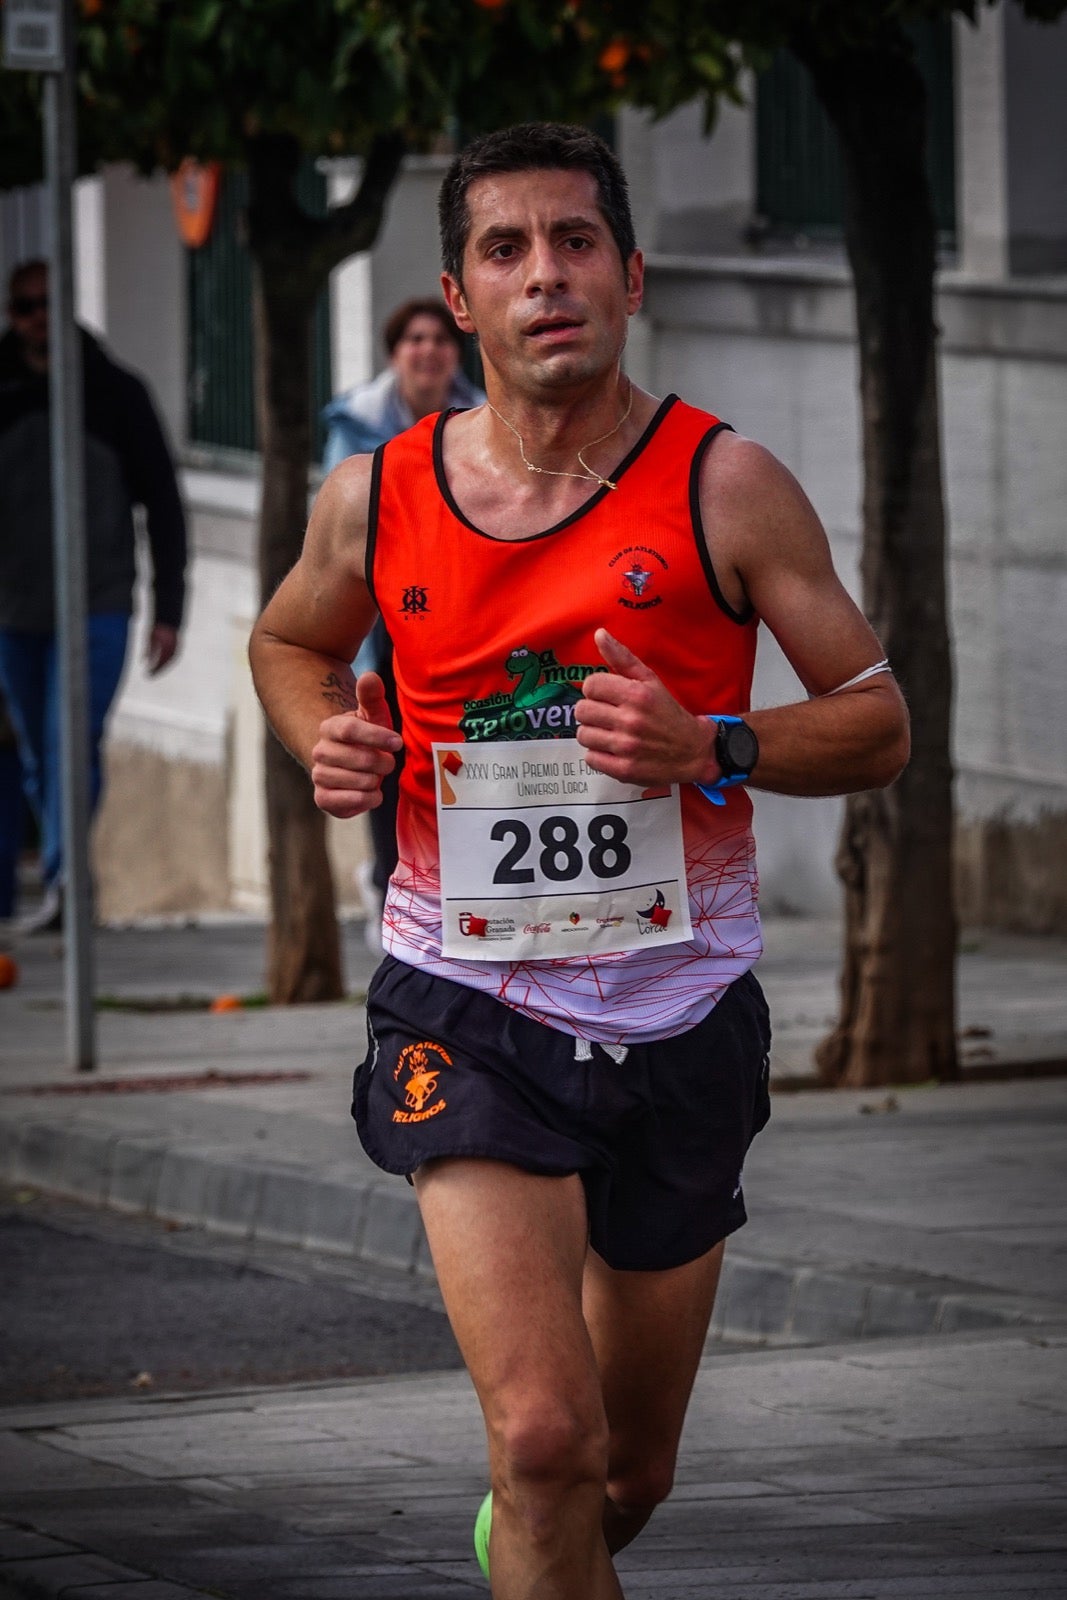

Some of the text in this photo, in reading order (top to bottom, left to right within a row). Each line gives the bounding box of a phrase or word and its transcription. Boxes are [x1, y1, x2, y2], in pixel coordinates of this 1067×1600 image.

[465, 762, 490, 780] XXXV
[490, 814, 632, 885] 288
[486, 925, 516, 933] Granada
[392, 1098, 448, 1123] PELIGROS
